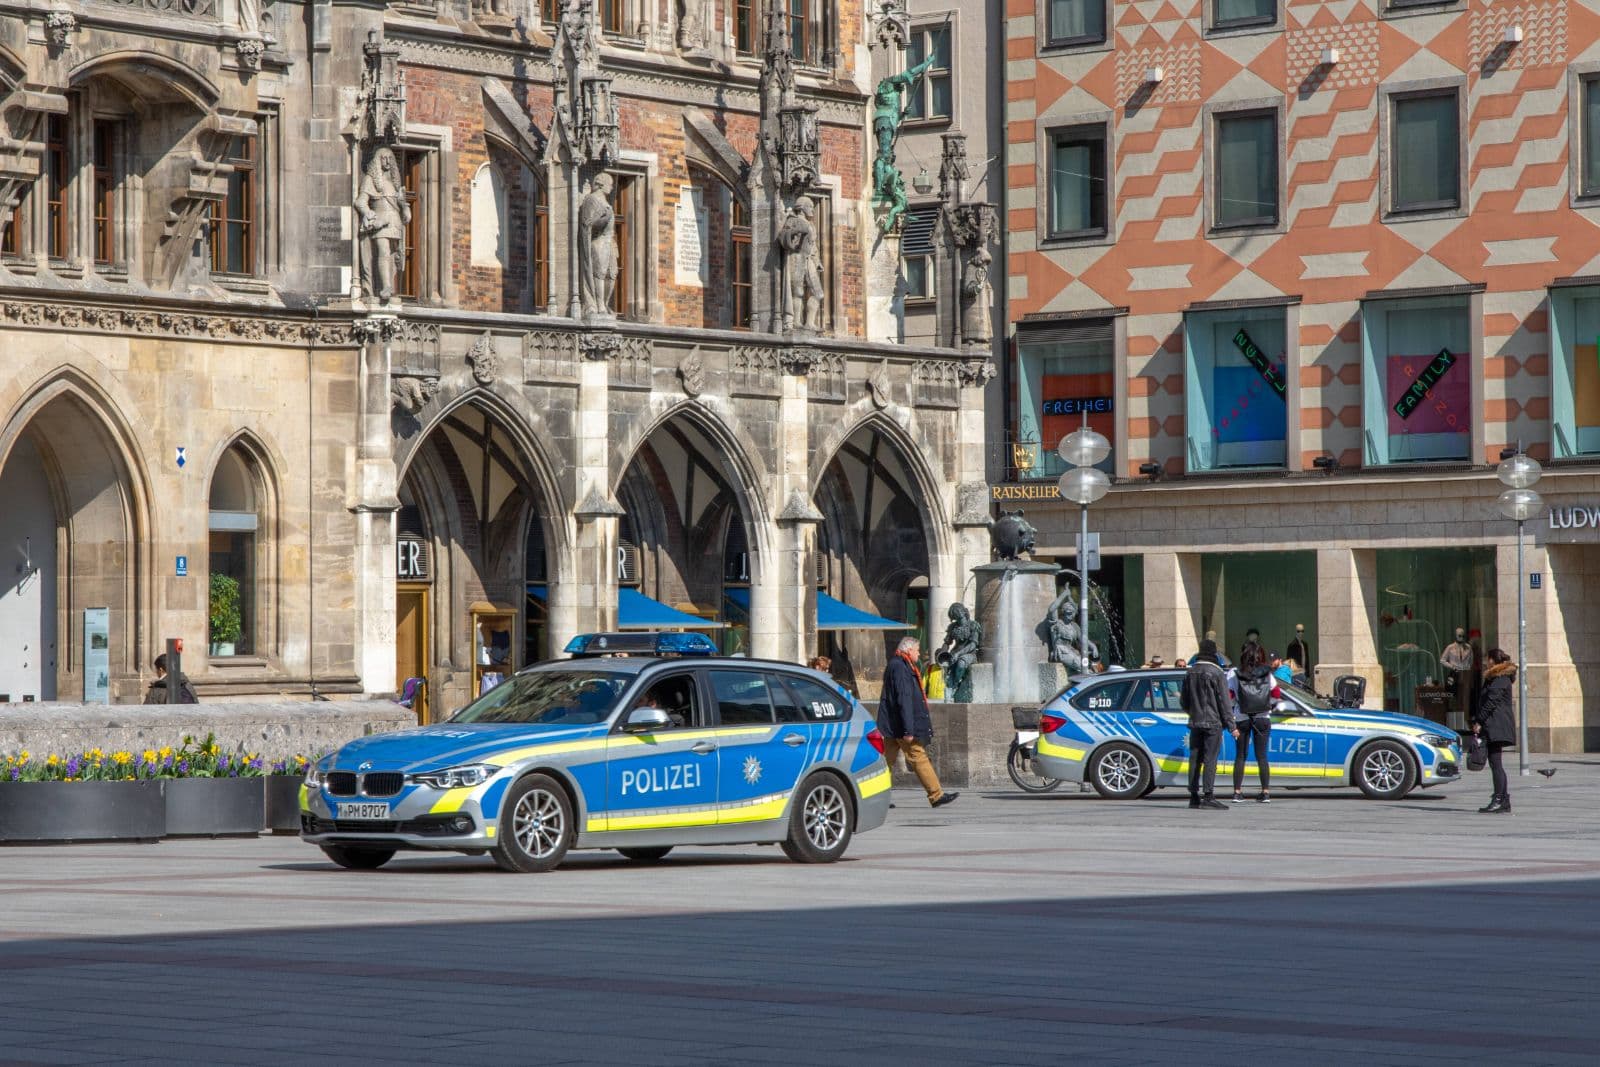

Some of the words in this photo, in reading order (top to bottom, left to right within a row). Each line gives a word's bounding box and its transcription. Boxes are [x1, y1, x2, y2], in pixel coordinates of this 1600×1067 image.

[1395, 351, 1451, 417] FAMILY
[992, 485, 1061, 499] RATSKELLER
[398, 540, 421, 576] ER
[821, 702, 836, 717] 110
[1098, 698, 1112, 708] 110
[1249, 736, 1313, 755] LIZEI
[621, 762, 701, 796] POLIZEI
[361, 804, 387, 818] 8707
